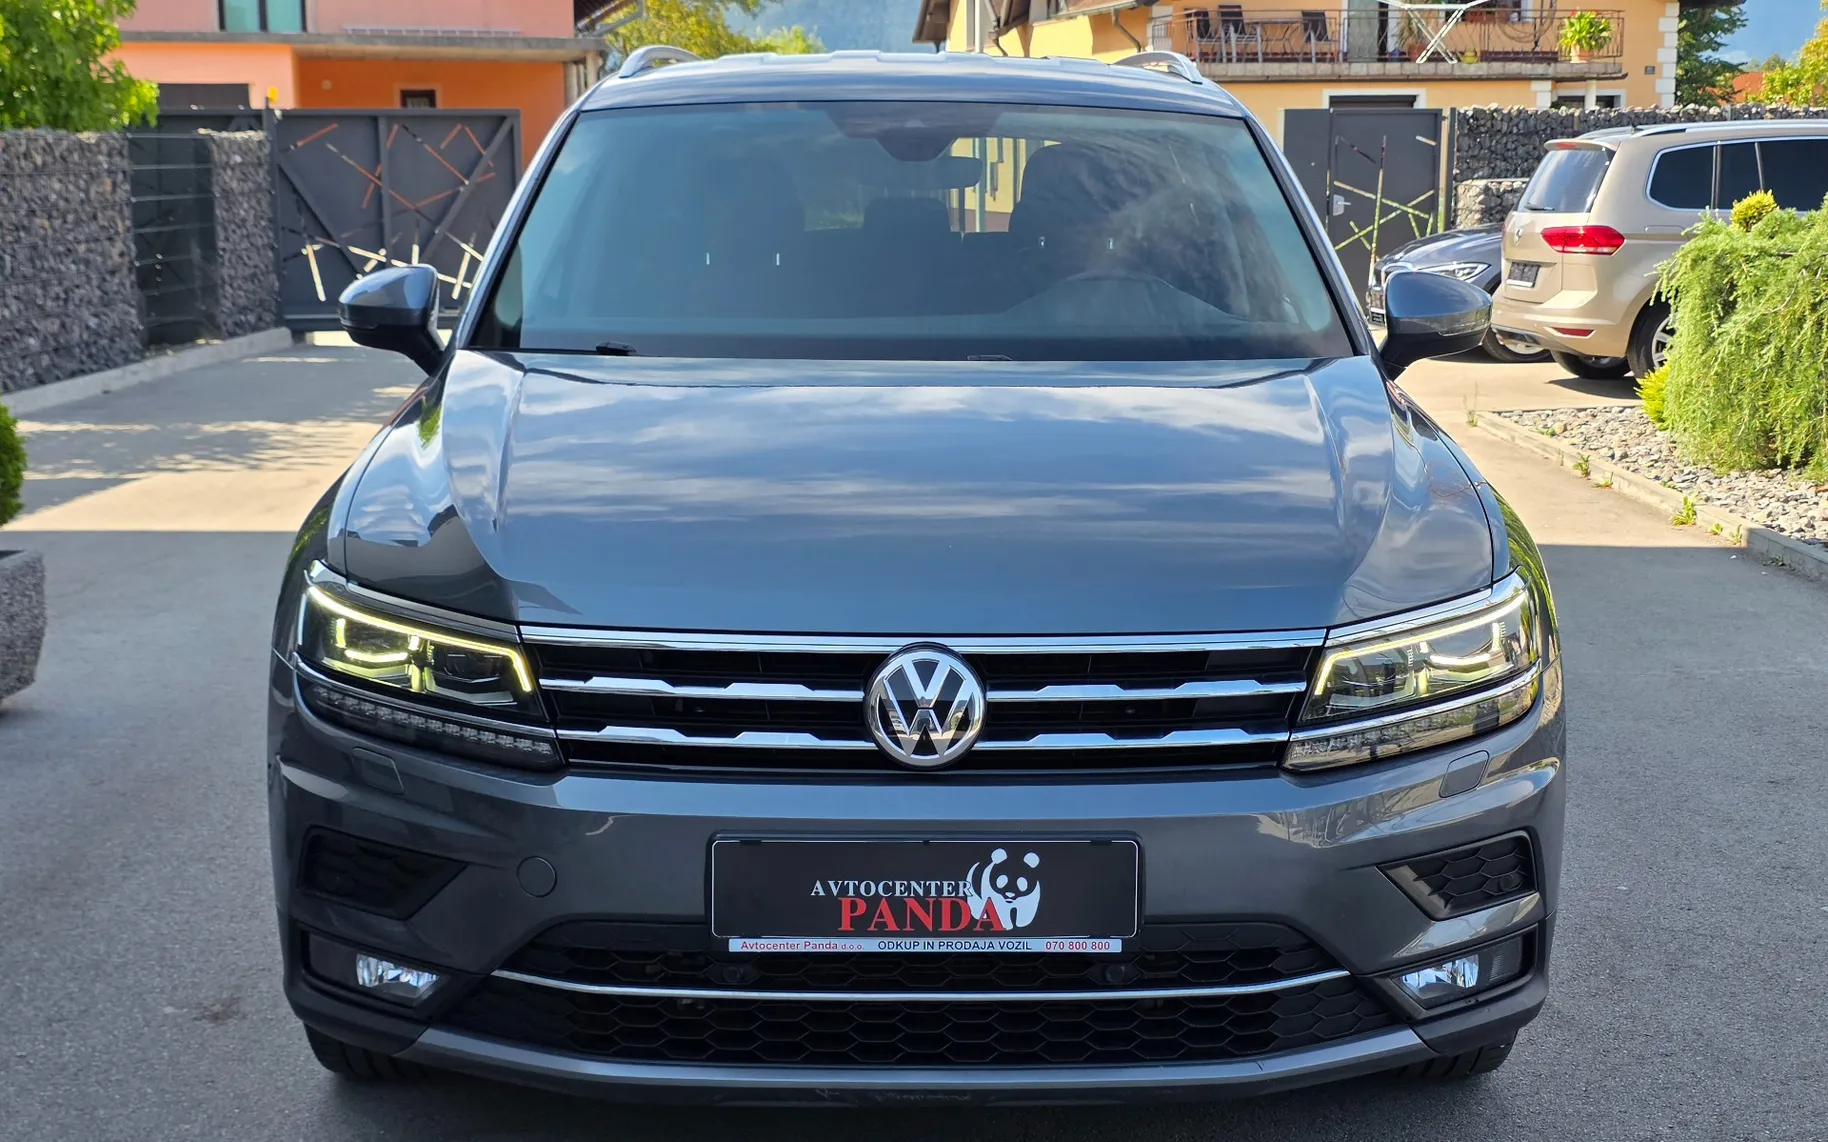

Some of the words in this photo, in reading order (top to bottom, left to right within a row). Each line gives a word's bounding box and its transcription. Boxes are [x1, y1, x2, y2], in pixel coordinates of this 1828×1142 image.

[811, 880, 973, 897] AVTOCENTER
[838, 897, 1006, 932] PANDA
[741, 941, 800, 950] Avtocenter
[803, 941, 838, 950] Panda
[877, 941, 920, 950] ODKUP
[923, 940, 934, 950] IN
[938, 940, 997, 950] PRODAJA
[999, 940, 1032, 950] VOZIL
[1045, 941, 1065, 950] 070
[1068, 941, 1088, 950] 800
[1091, 941, 1110, 950] 800
